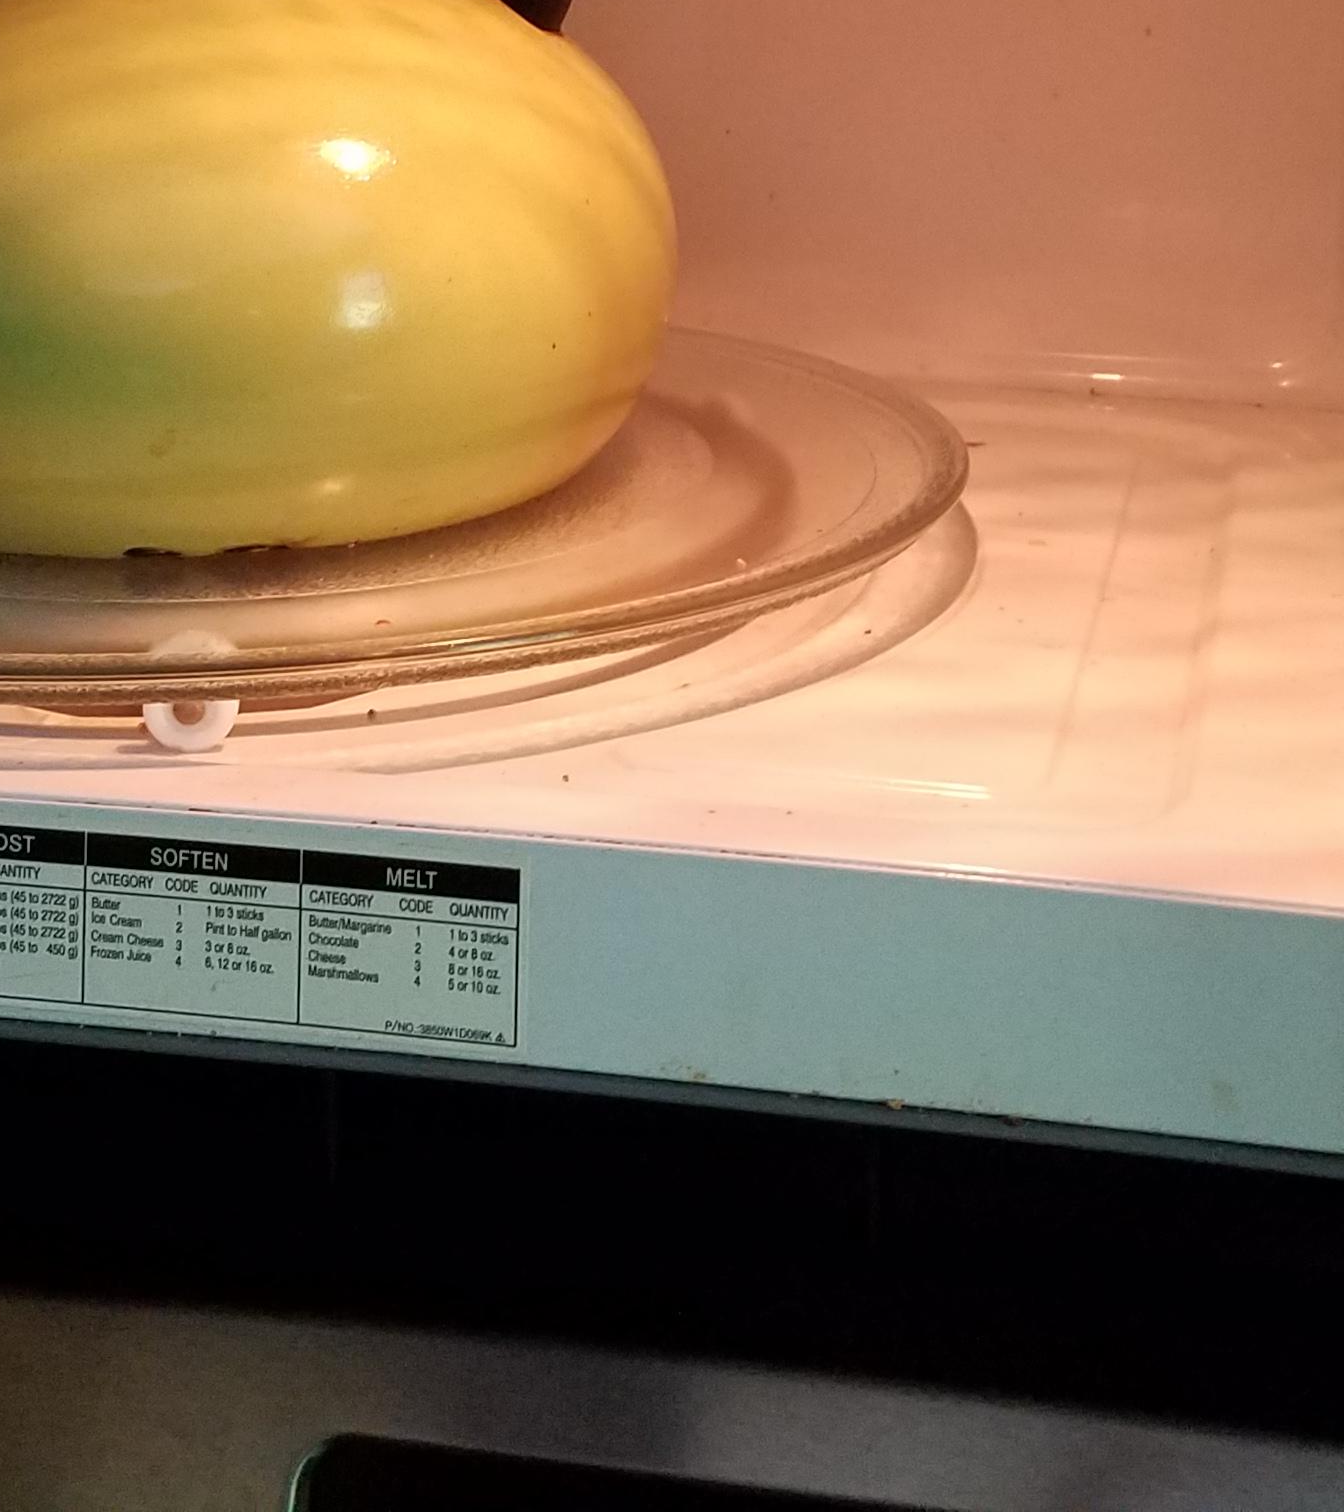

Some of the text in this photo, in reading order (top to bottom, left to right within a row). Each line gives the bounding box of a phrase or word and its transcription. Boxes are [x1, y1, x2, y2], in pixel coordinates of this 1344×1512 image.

[150, 847, 228, 871] SOFTEN
[91, 872, 267, 899] CATEGORY CODE QUANTITY
[386, 867, 438, 889] MELT
[10, 891, 26, 905] (45
[28, 891, 39, 905] to
[41, 893, 66, 906] 2722
[309, 890, 509, 921] CATEGORY CODE QUANTITY
[10, 907, 25, 921] (45
[28, 908, 38, 921] to
[41, 909, 66, 923] 2722
[92, 897, 264, 921] Butter sticks
[10, 923, 25, 937] (45
[28, 925, 38, 937] to
[41, 926, 66, 939] 2722
[109, 915, 292, 942] Cream Pint Half gallon
[309, 915, 509, 946] Butter/Margarine sticks
[28, 941, 38, 954] to
[46, 943, 65, 956] 450
[91, 930, 164, 949] Cream Cheese
[309, 932, 359, 949] Chocolate
[91, 946, 229, 970] Frozen Juice 12
[308, 950, 346, 965] Cheese
[308, 966, 379, 984] Marshmallows
